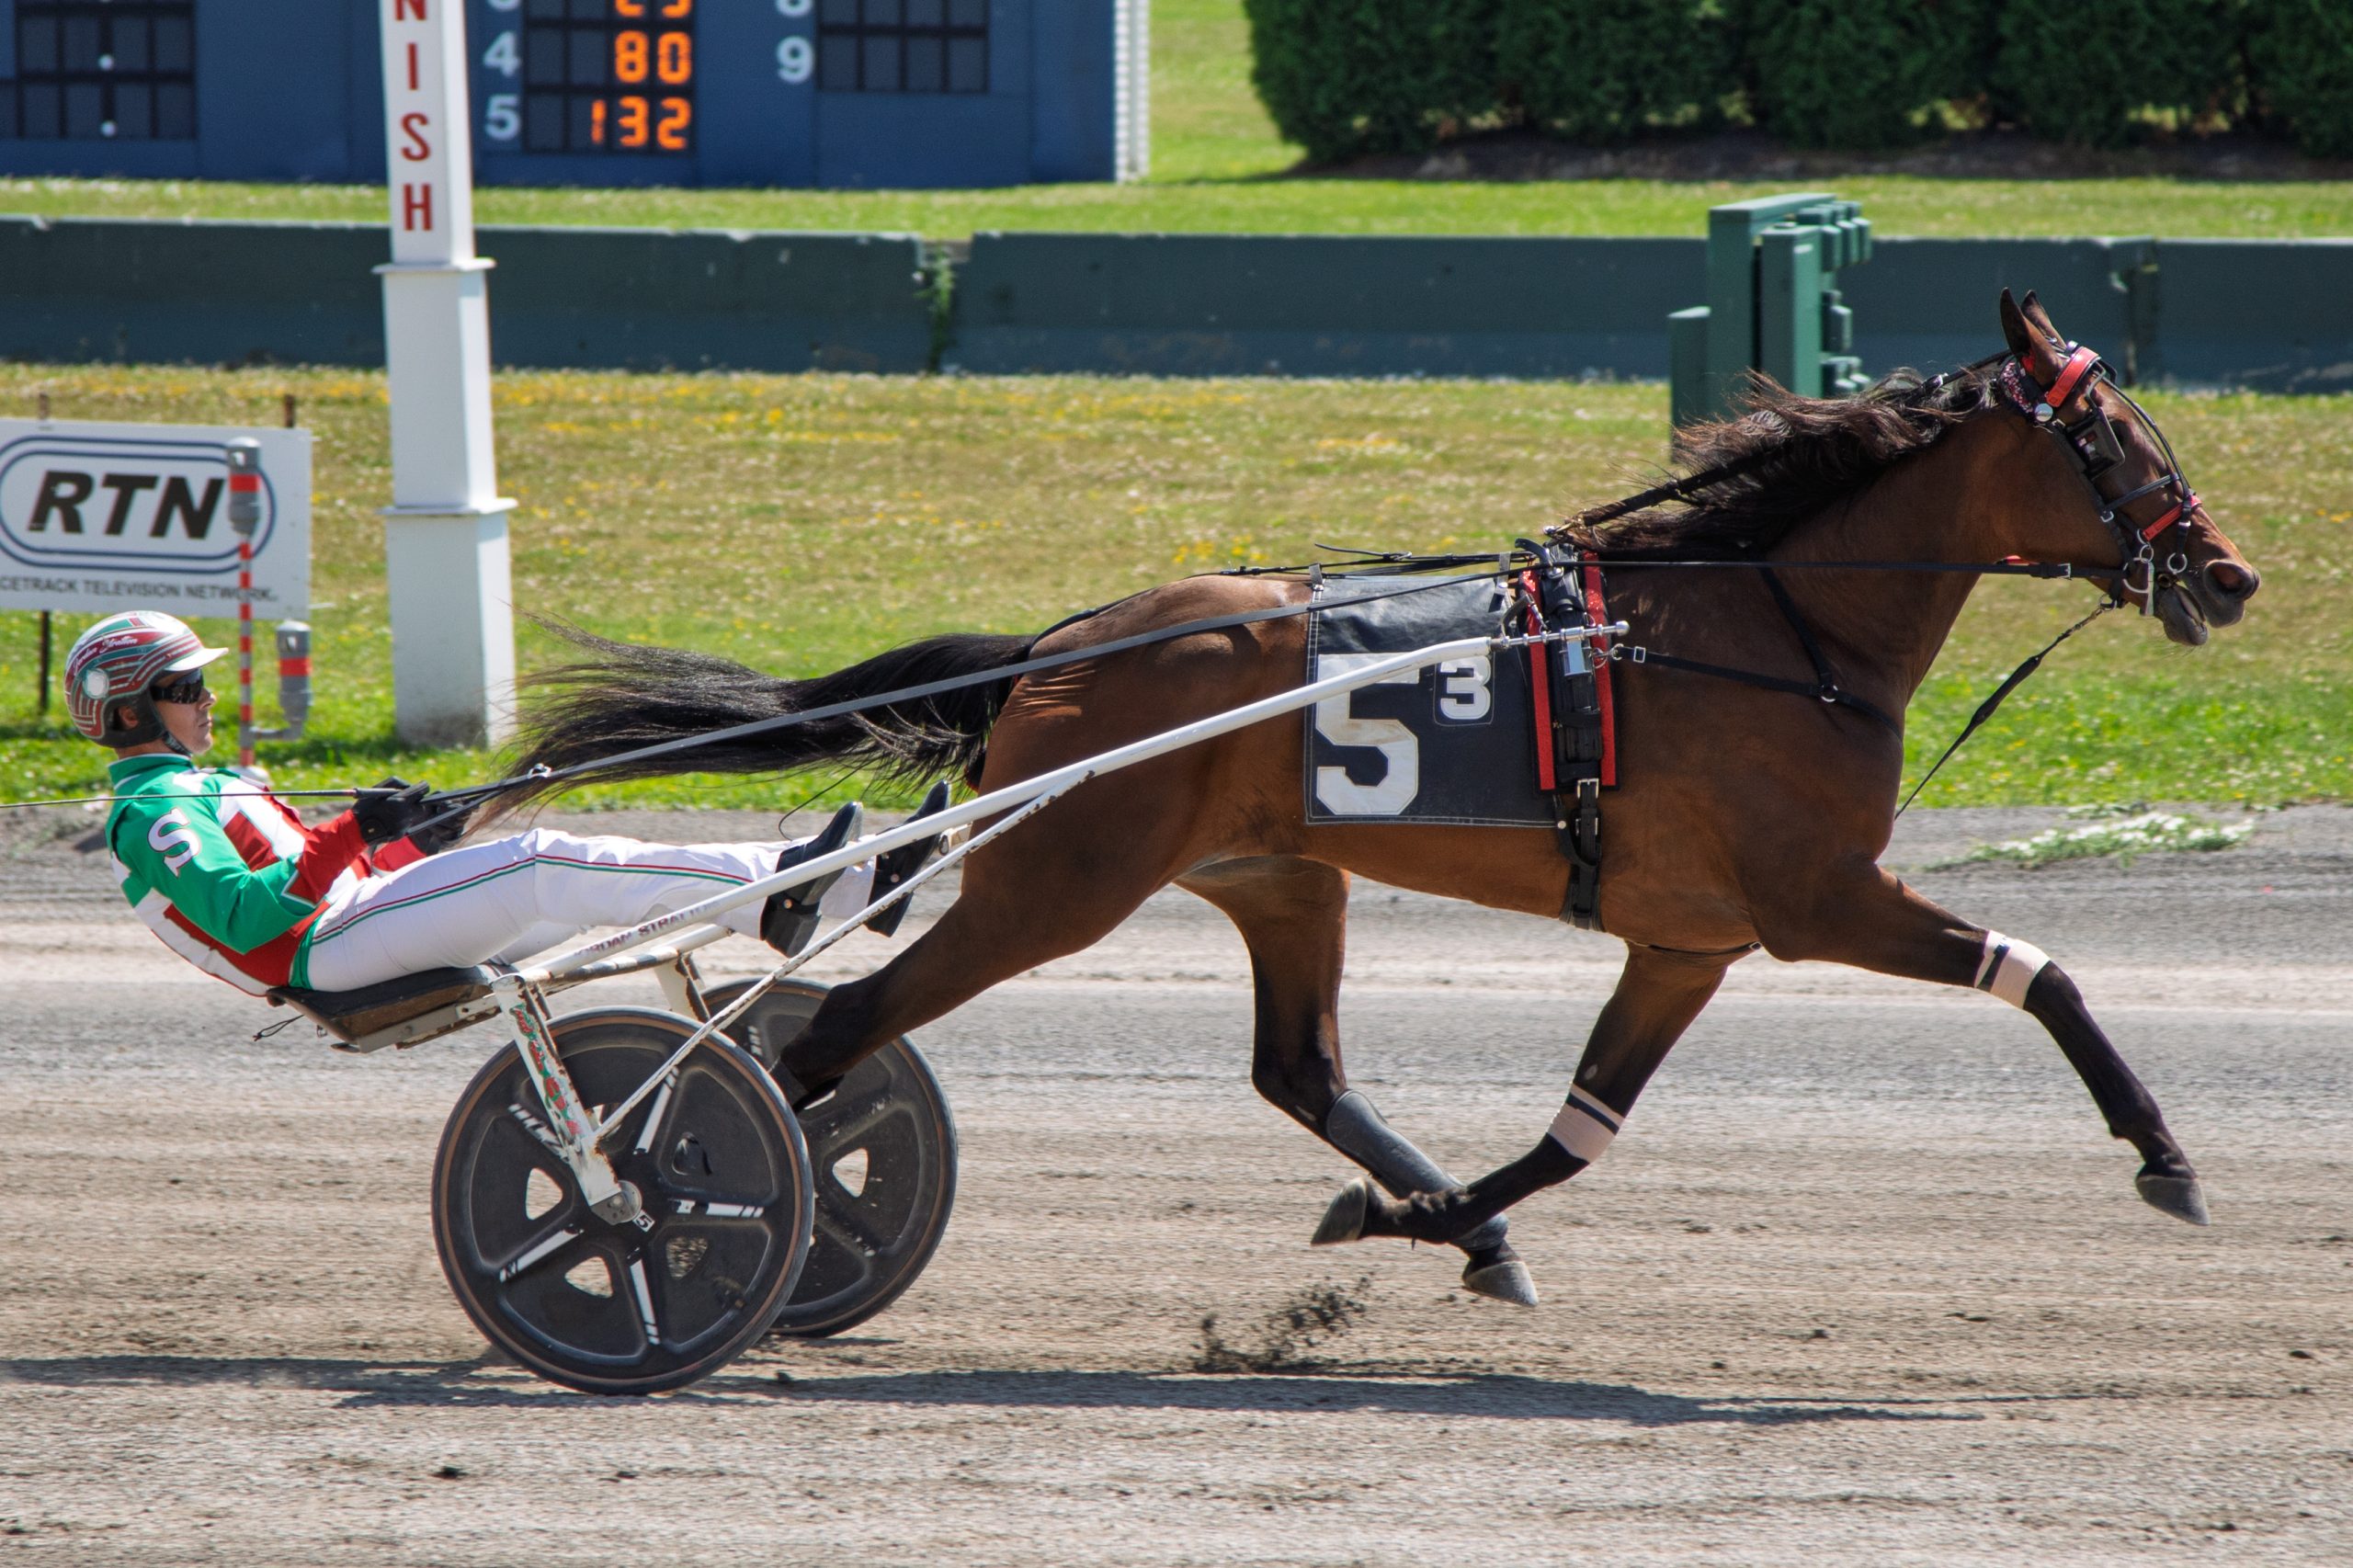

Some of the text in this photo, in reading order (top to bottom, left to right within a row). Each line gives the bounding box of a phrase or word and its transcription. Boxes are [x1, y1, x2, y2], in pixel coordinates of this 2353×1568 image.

[483, 29, 692, 85] 4 80
[776, 35, 814, 85] 9
[484, 94, 692, 151] 5 132
[28, 470, 225, 540] RTN
[83, 578, 180, 598] TELEVISION
[1439, 654, 1492, 720] 3
[1315, 653, 1419, 815] 5
[147, 807, 202, 878] S
